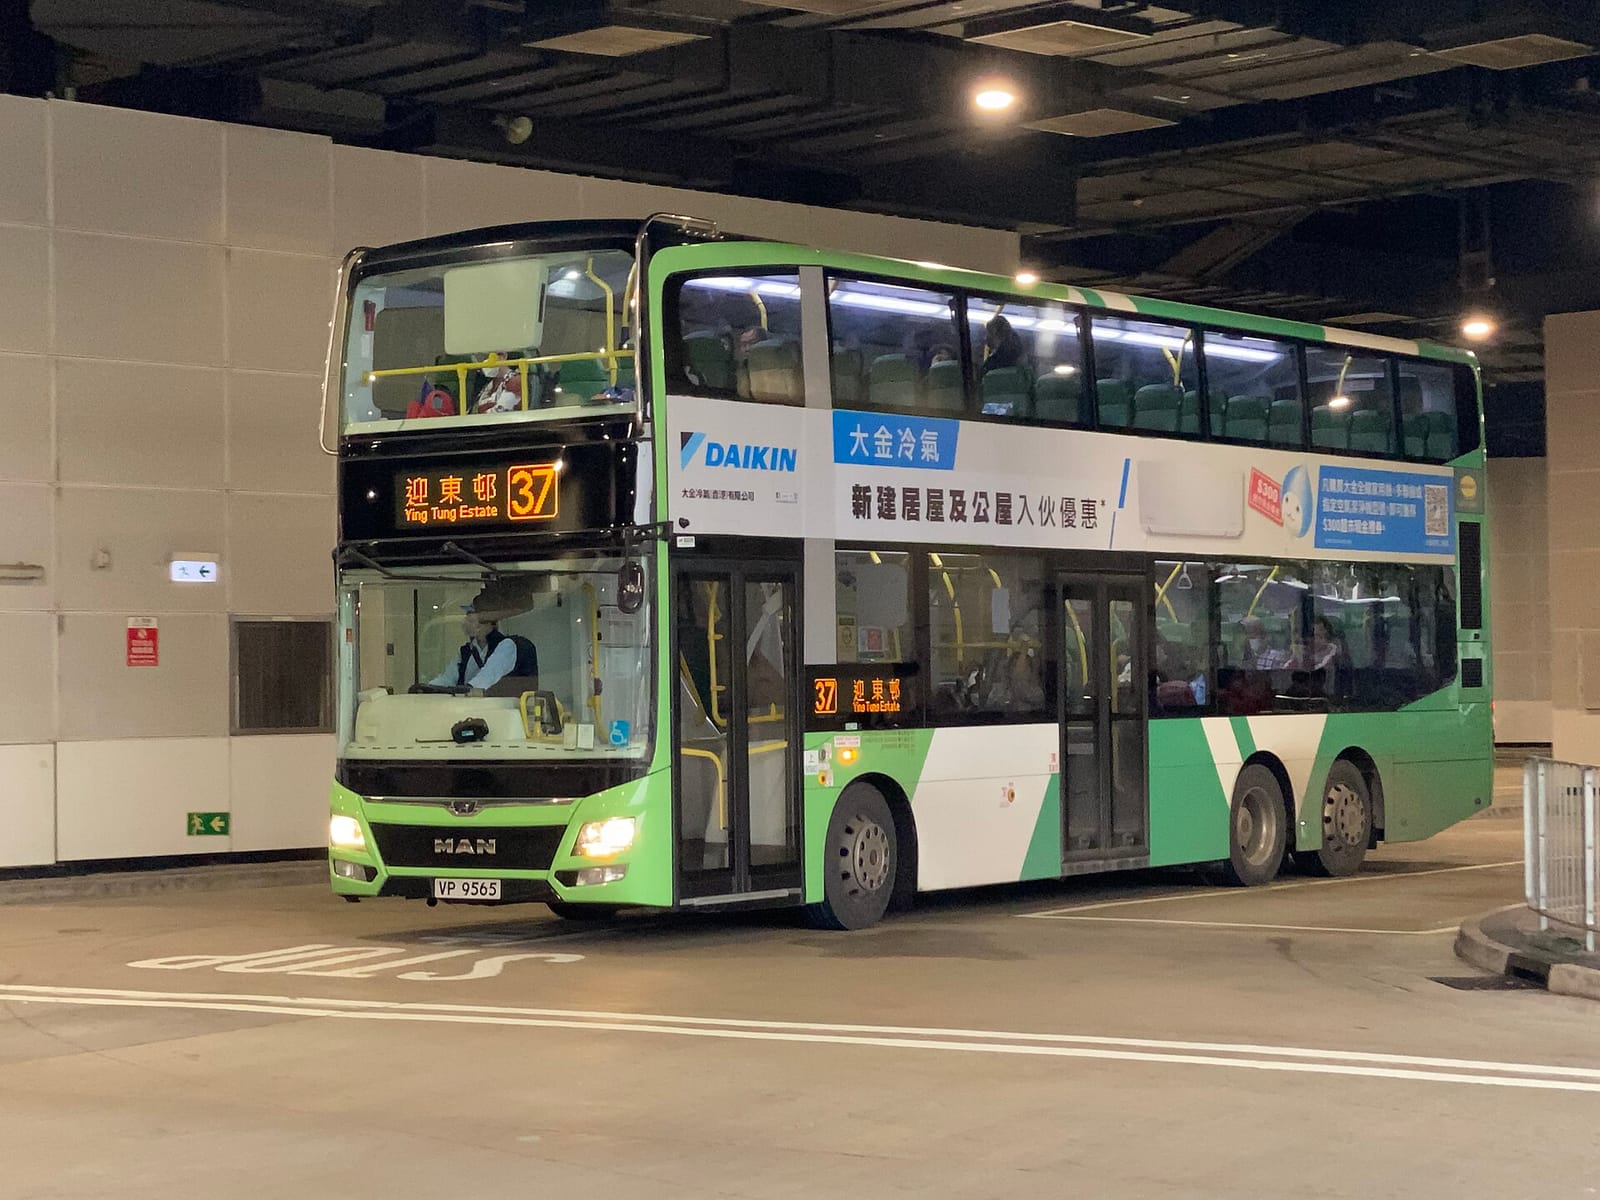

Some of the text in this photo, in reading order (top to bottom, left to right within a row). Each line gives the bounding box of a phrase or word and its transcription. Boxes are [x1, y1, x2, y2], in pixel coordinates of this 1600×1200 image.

[705, 441, 797, 472] DAIKIN
[849, 423, 940, 462] 大金冷氣
[405, 473, 496, 507] 迎東邨
[511, 468, 556, 514] 37
[404, 505, 498, 523] Ying Tung Estate
[815, 681, 836, 711] 37
[853, 678, 900, 701] 迎東邨
[434, 838, 496, 854] MAN
[439, 881, 497, 896] VP 9565
